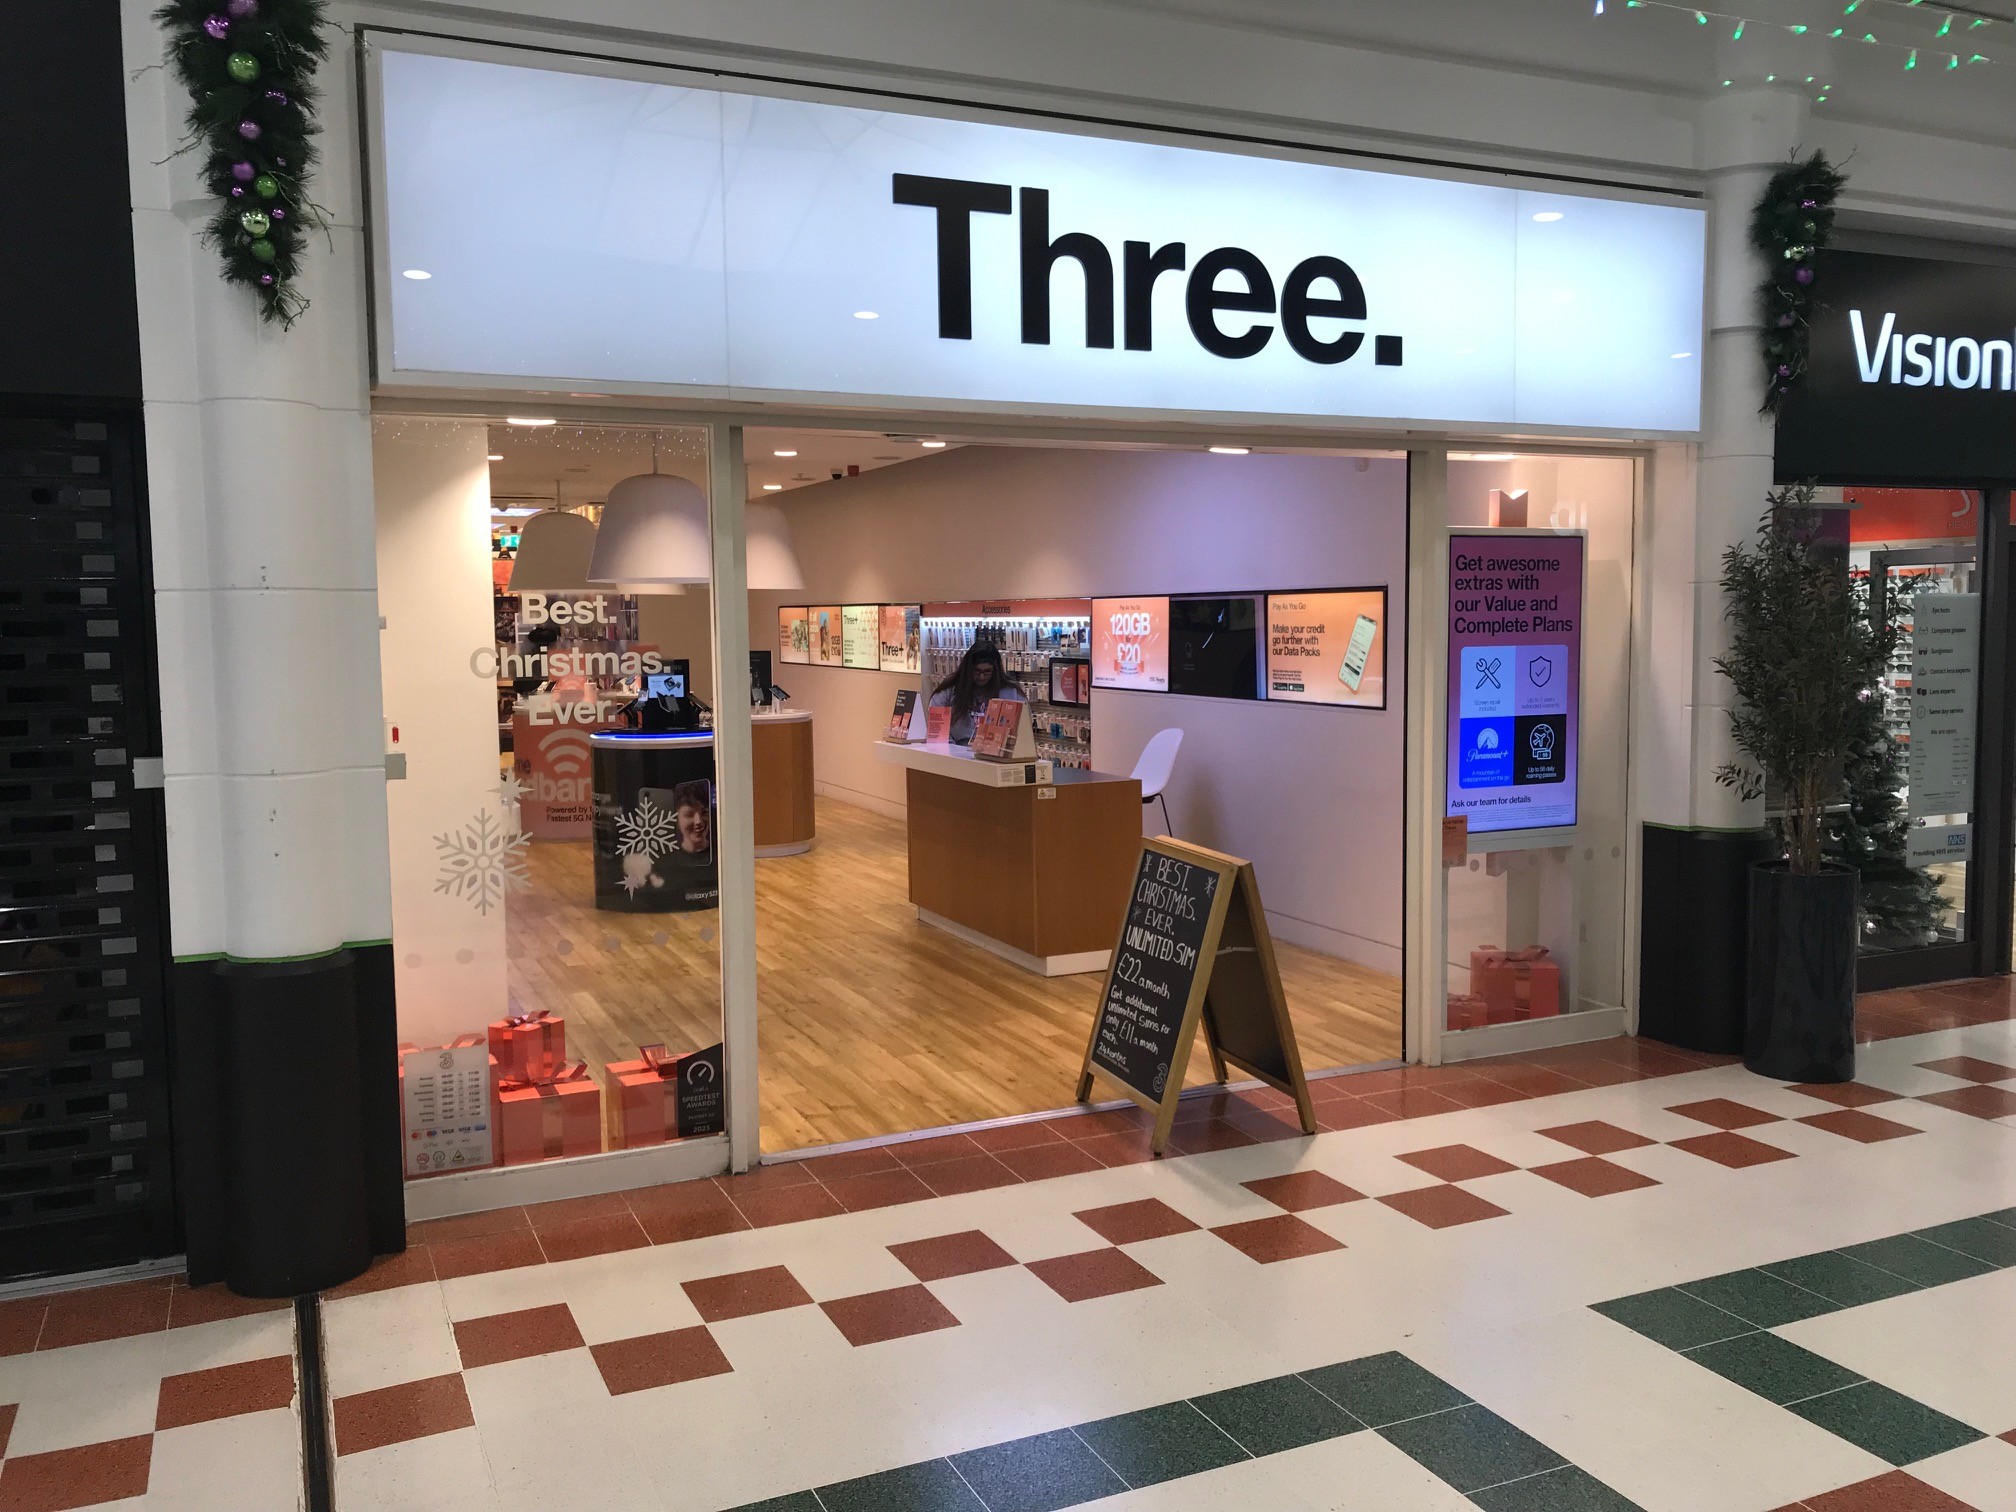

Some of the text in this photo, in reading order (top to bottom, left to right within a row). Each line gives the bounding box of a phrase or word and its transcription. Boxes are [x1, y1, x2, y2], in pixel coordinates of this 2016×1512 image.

[893, 173, 1402, 366] Three.
[1850, 310, 2016, 392] Vision
[1455, 554, 1560, 571] Get awesome
[1455, 574, 1539, 590] extras with
[522, 593, 617, 625] Best.
[982, 604, 1010, 614] Accessories
[1455, 595, 1558, 612] our Value and
[1110, 612, 1151, 635] 120GB
[1273, 624, 1325, 635] Make your credit
[1454, 616, 1573, 636] Complete Plans
[1272, 635, 1319, 646] go further with
[1117, 642, 1141, 663] £20
[1272, 646, 1320, 656] our Data Packs
[469, 646, 671, 679] Christmas.
[528, 695, 616, 726] Ever.
[1451, 800, 1464, 808] Ask
[1498, 797, 1508, 805] for
[1509, 795, 1531, 804] details
[573, 814, 584, 822] 5G
[1157, 857, 1193, 892] BEST.
[1137, 879, 1196, 921] CHRISTMAS.
[1144, 908, 1175, 935] EVER.
[1126, 925, 1196, 971] UNLIMITED SIM
[1117, 953, 1142, 983] £22
[1145, 979, 1170, 999] month
[1107, 1001, 1138, 1021] unlimited
[1110, 985, 1158, 1017] Get additional
[1105, 1014, 1120, 1032] only
[1119, 1020, 1135, 1044] £11
[1139, 1038, 1159, 1055] month
[681, 1092, 720, 1104] SPEEDTEST
[686, 1100, 716, 1109] AWARDS
[693, 1125, 711, 1133] 2023
